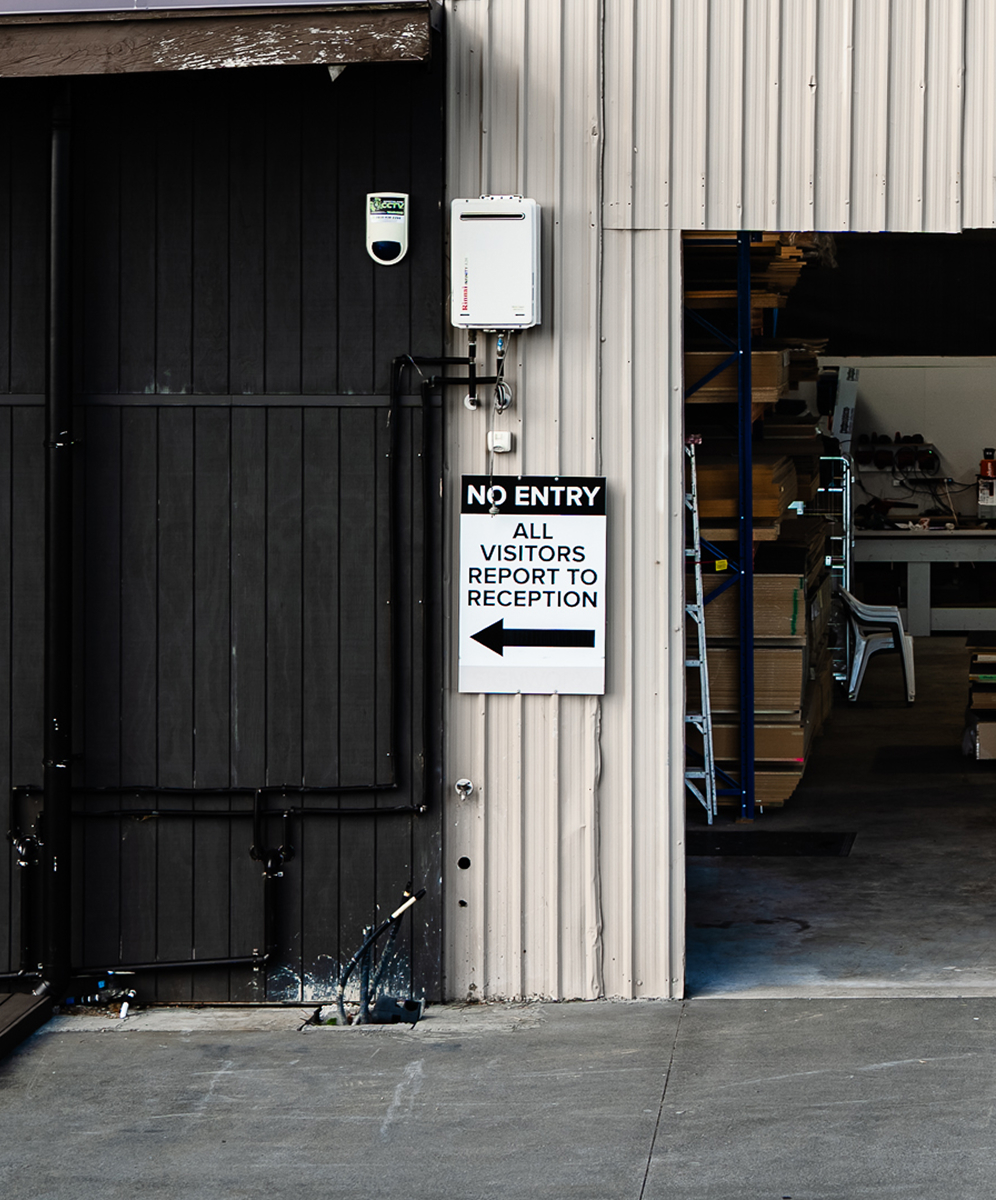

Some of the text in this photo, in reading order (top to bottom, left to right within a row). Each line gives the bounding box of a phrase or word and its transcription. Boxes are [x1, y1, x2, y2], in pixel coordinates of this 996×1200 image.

[467, 484, 601, 507] NO ENTRY
[512, 522, 554, 539] ALL
[480, 544, 586, 562] VISITORS
[468, 567, 598, 585] REPORT TO
[468, 590, 598, 608] RECEPTION
